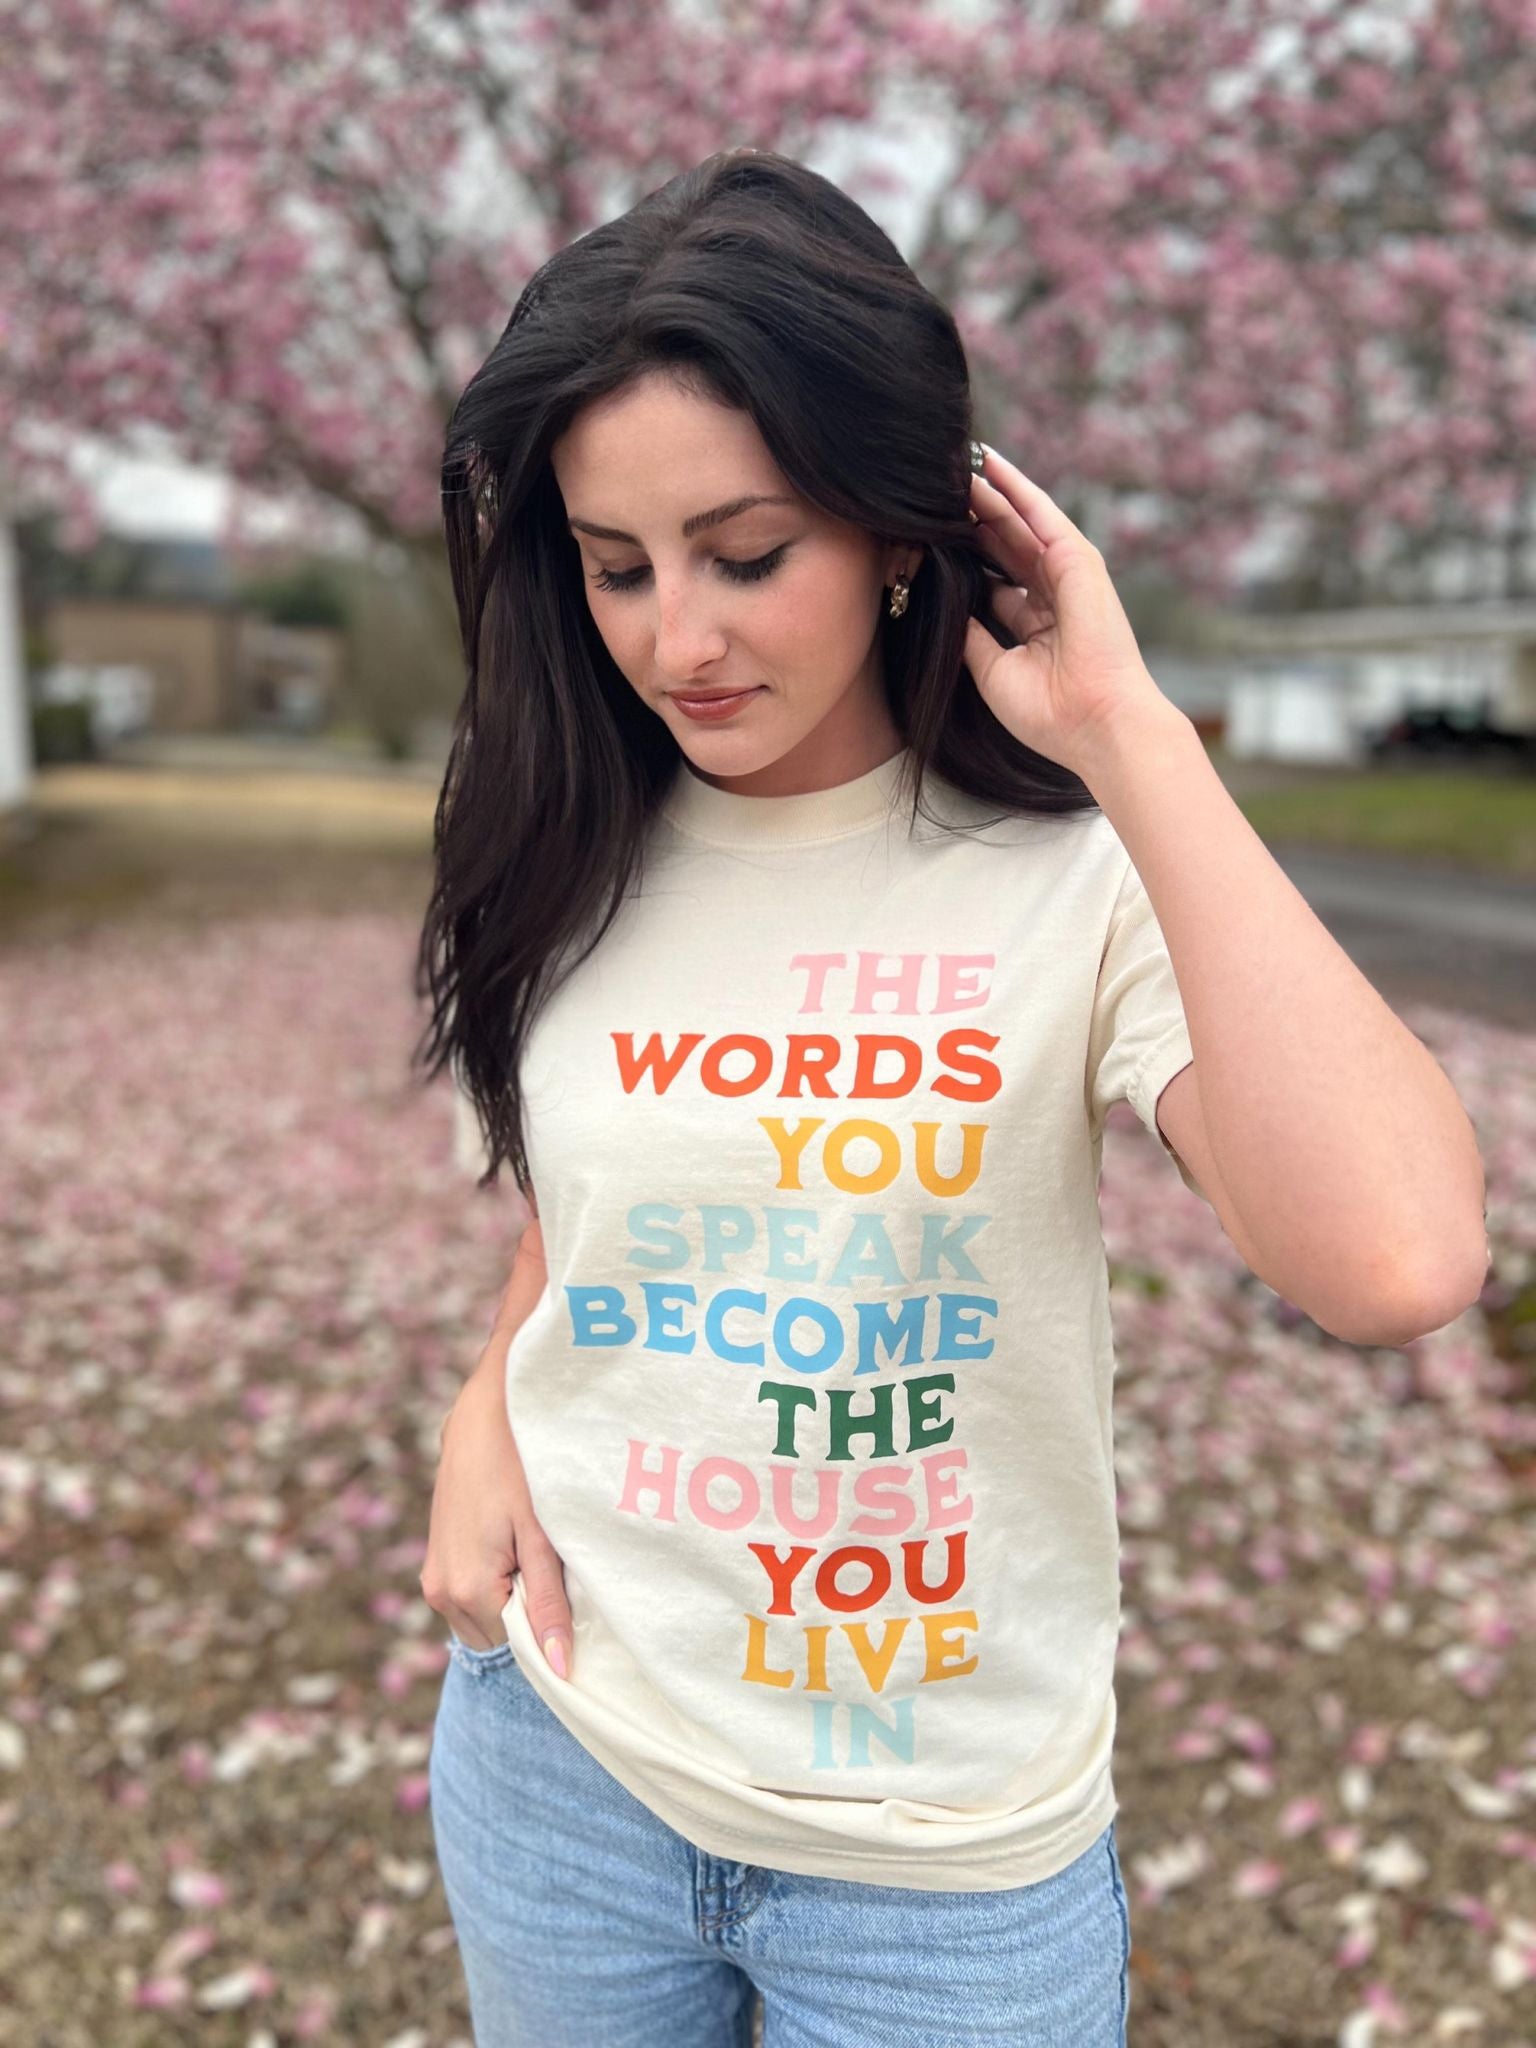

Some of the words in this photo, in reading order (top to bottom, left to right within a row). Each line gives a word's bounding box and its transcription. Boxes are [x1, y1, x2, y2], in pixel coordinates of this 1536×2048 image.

[791, 953, 996, 1015] THE
[610, 1028, 1002, 1102] WORDS
[757, 1116, 989, 1197] YOU
[628, 1205, 990, 1285] SPEAK
[564, 1283, 998, 1375] BECOME
[758, 1374, 956, 1460] THE
[617, 1440, 974, 1539] HOUSE
[747, 1531, 968, 1616] YOU
[741, 1611, 980, 1693] LIVE
[812, 1699, 916, 1768] IN
